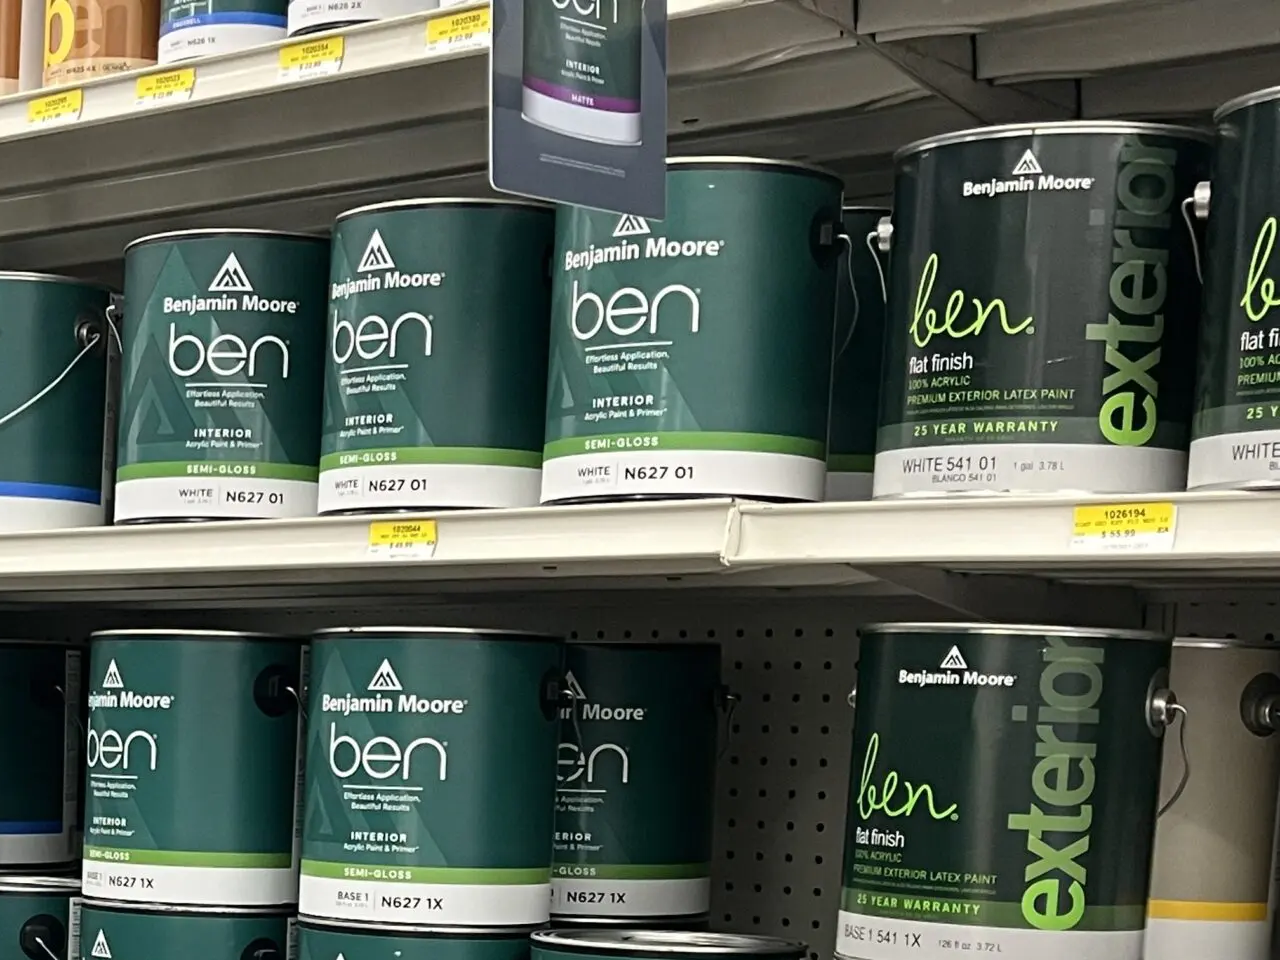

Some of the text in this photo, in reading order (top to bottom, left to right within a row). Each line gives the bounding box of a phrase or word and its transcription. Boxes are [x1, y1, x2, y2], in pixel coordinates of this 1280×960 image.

[566, 59, 600, 74] INTERIOR
[572, 94, 594, 106] MATTE
[963, 174, 1091, 197] Benjamin Moore
[565, 237, 720, 271] Benjamin Moore
[1085, 134, 1179, 447] exterior
[164, 294, 297, 315] Benjamin Moore
[572, 280, 699, 340] ben
[593, 362, 658, 373] Beautiful Results
[909, 352, 973, 375] flat finish
[931, 376, 970, 388] ACRYLIC
[593, 395, 654, 408] INTERIOR
[907, 389, 1075, 405] PREMIUM EXTERIOR LATEX PAINT
[914, 421, 1058, 437] 25 YEAR WARRANTY
[585, 436, 659, 449] SEMI-GLOSS
[340, 452, 397, 464] SEMI-GLOSS
[902, 457, 943, 473] WHITE
[947, 457, 971, 471] 541
[186, 464, 256, 475] SEMI-GLOSS
[577, 466, 610, 477] WHITE
[625, 467, 668, 479] N627
[369, 479, 404, 492] N627
[179, 488, 213, 498] WHITE
[226, 491, 263, 504] N627
[1104, 509, 1145, 519] 1026194
[322, 692, 464, 716] Benjamin Moore
[1008, 636, 1105, 931] exterior
[344, 868, 412, 880] SEMI-GLOSS
[109, 876, 153, 889] N627 1X
[337, 891, 361, 902] BASE
[381, 896, 421, 909] N627
[426, 898, 443, 910] 1X
[567, 892, 626, 904] N627 1X
[871, 896, 897, 909] YEAR
[904, 900, 980, 915] WARRANTY
[844, 924, 865, 941] BASE
[877, 929, 897, 944] 541
[904, 933, 921, 948] 1X
